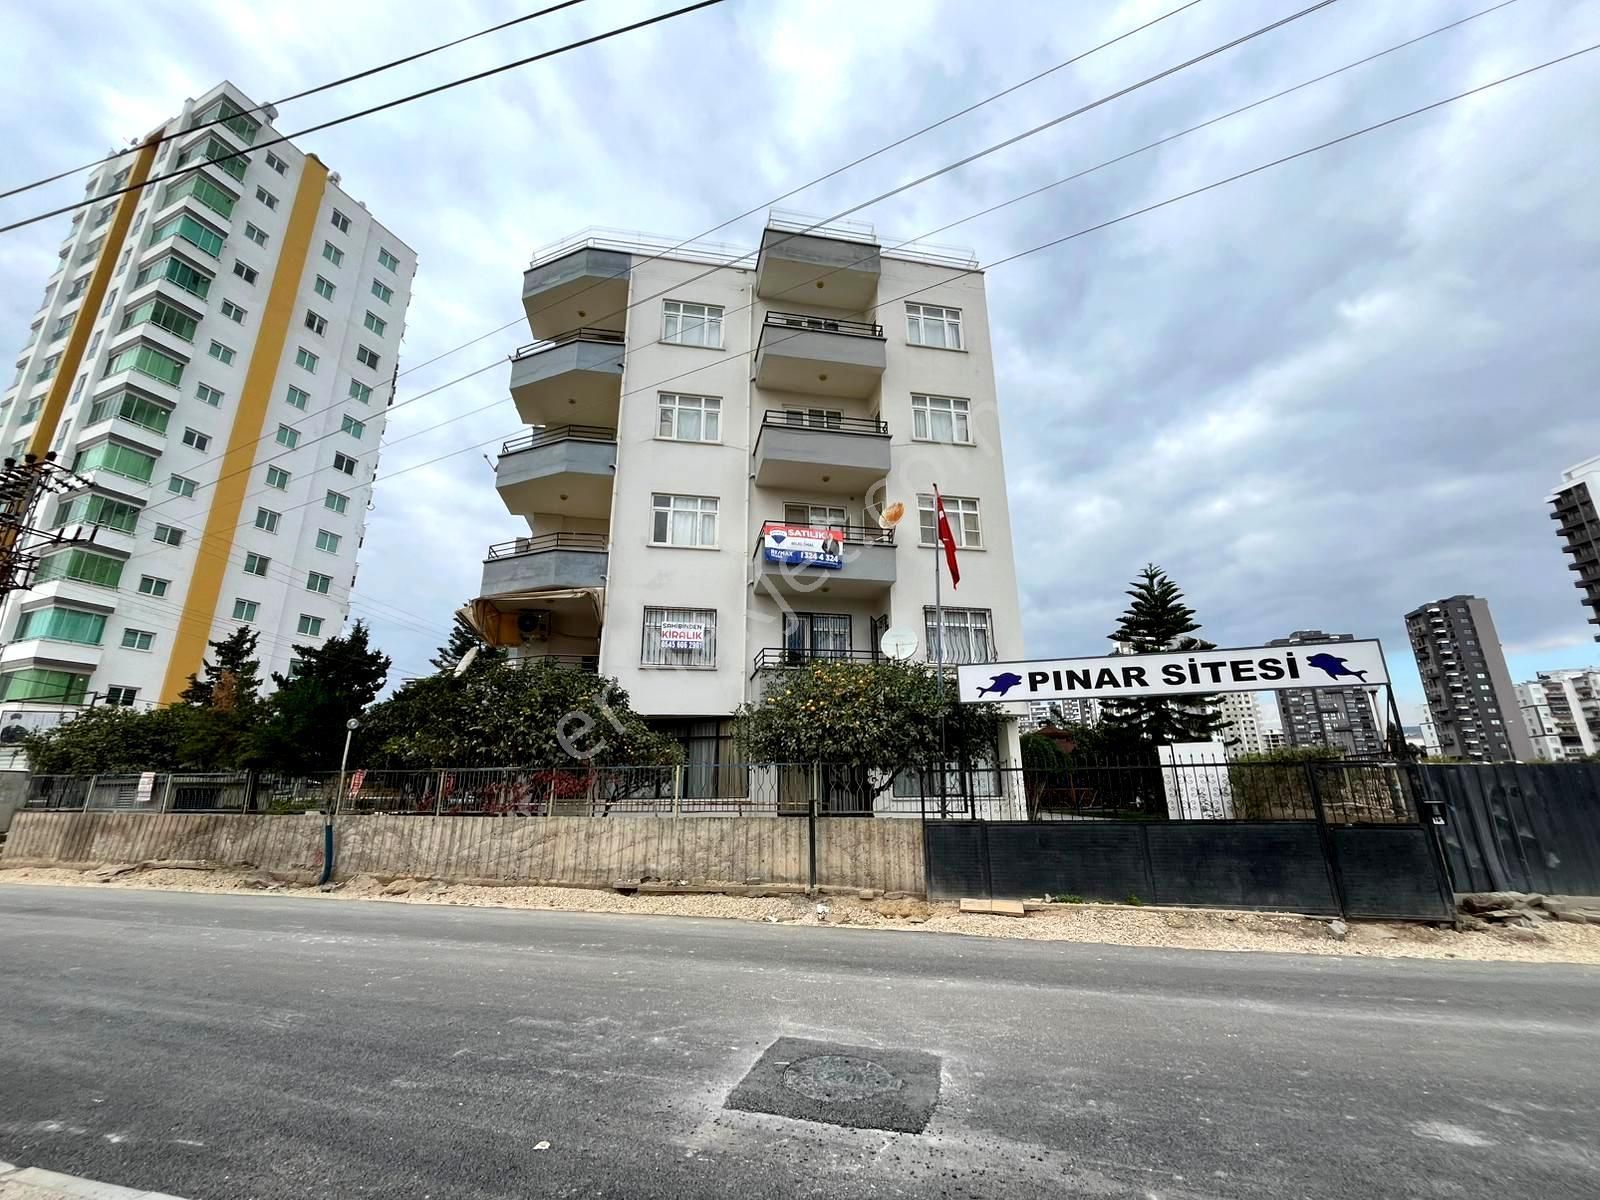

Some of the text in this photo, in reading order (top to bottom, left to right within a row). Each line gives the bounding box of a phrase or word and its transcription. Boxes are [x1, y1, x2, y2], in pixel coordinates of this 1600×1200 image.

[787, 528, 826, 540] SATILIK
[1028, 652, 1300, 692] PINAR SİTESİ
